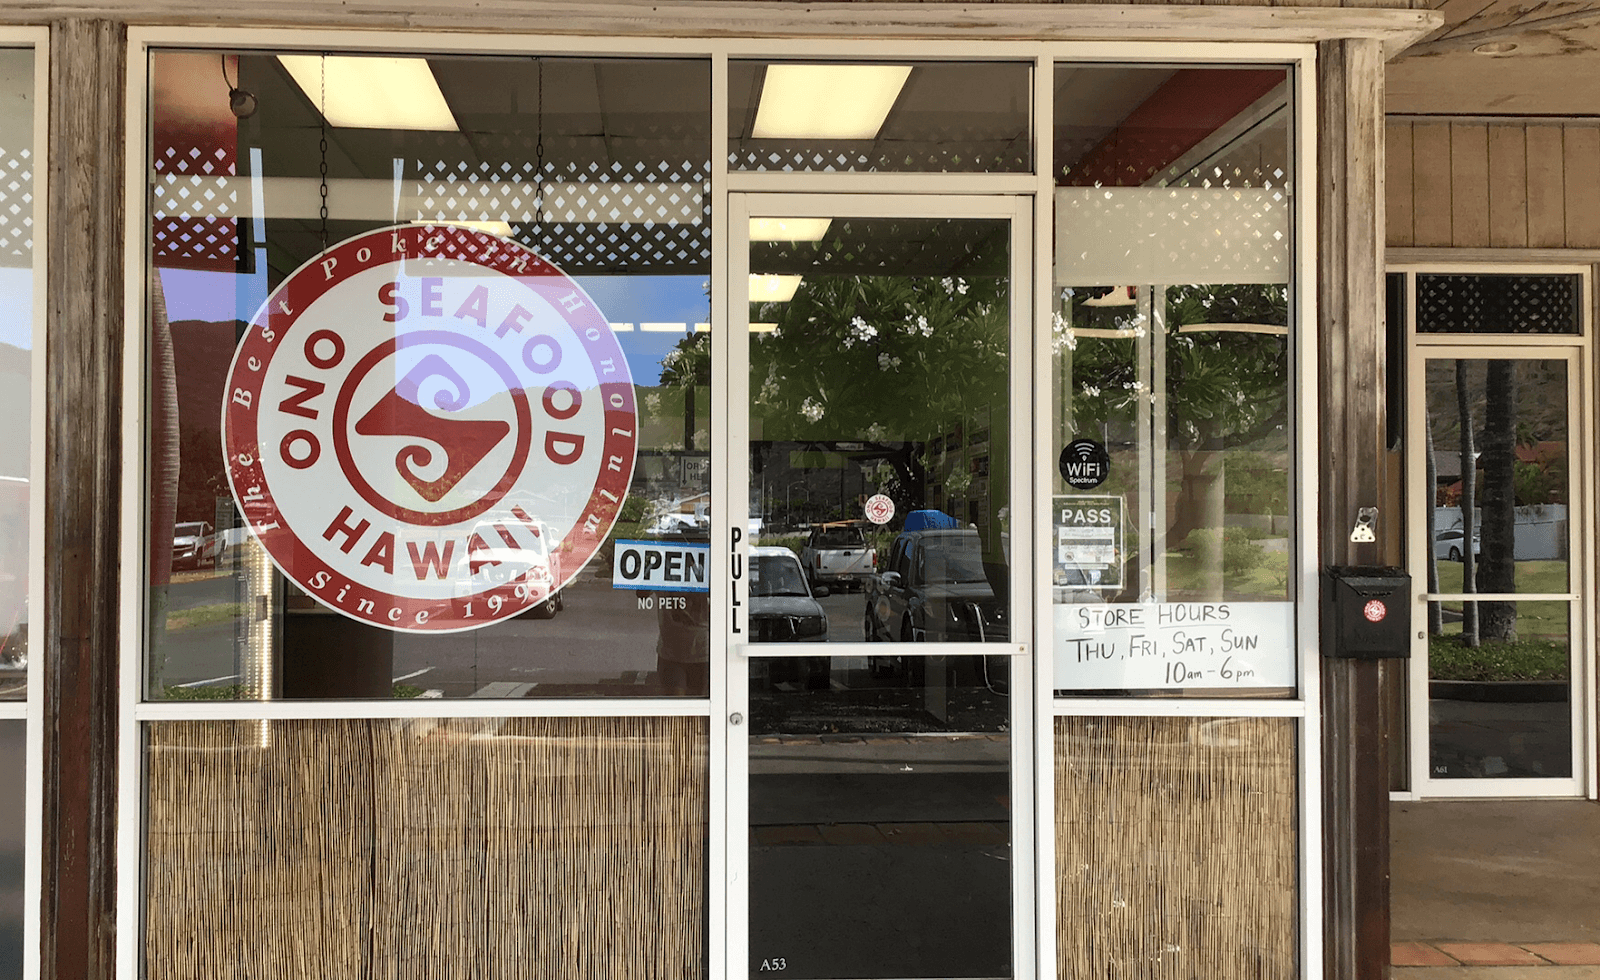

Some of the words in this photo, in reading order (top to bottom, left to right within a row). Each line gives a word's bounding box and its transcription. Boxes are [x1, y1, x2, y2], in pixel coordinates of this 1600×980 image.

[231, 298, 294, 410] Best
[320, 232, 439, 281] Poke
[483, 240, 530, 274] in
[557, 290, 632, 536] Honolulu
[278, 329, 346, 469] ONO
[378, 277, 585, 466] SEAFOOD
[1066, 462, 1100, 477] WiFi
[1069, 477, 1098, 485] Spectrum
[1061, 509, 1111, 523] PASS
[322, 504, 542, 580] HAWAII
[620, 549, 705, 583] OPEN
[731, 527, 742, 634] PULL
[308, 570, 429, 624] Since
[463, 573, 553, 618] 199
[637, 597, 654, 610] NO
[659, 597, 687, 610] PETS
[1078, 607, 1144, 629] STORE
[1158, 604, 1231, 625] HOURS
[1220, 629, 1258, 652] SUN
[759, 957, 787, 971] A53
